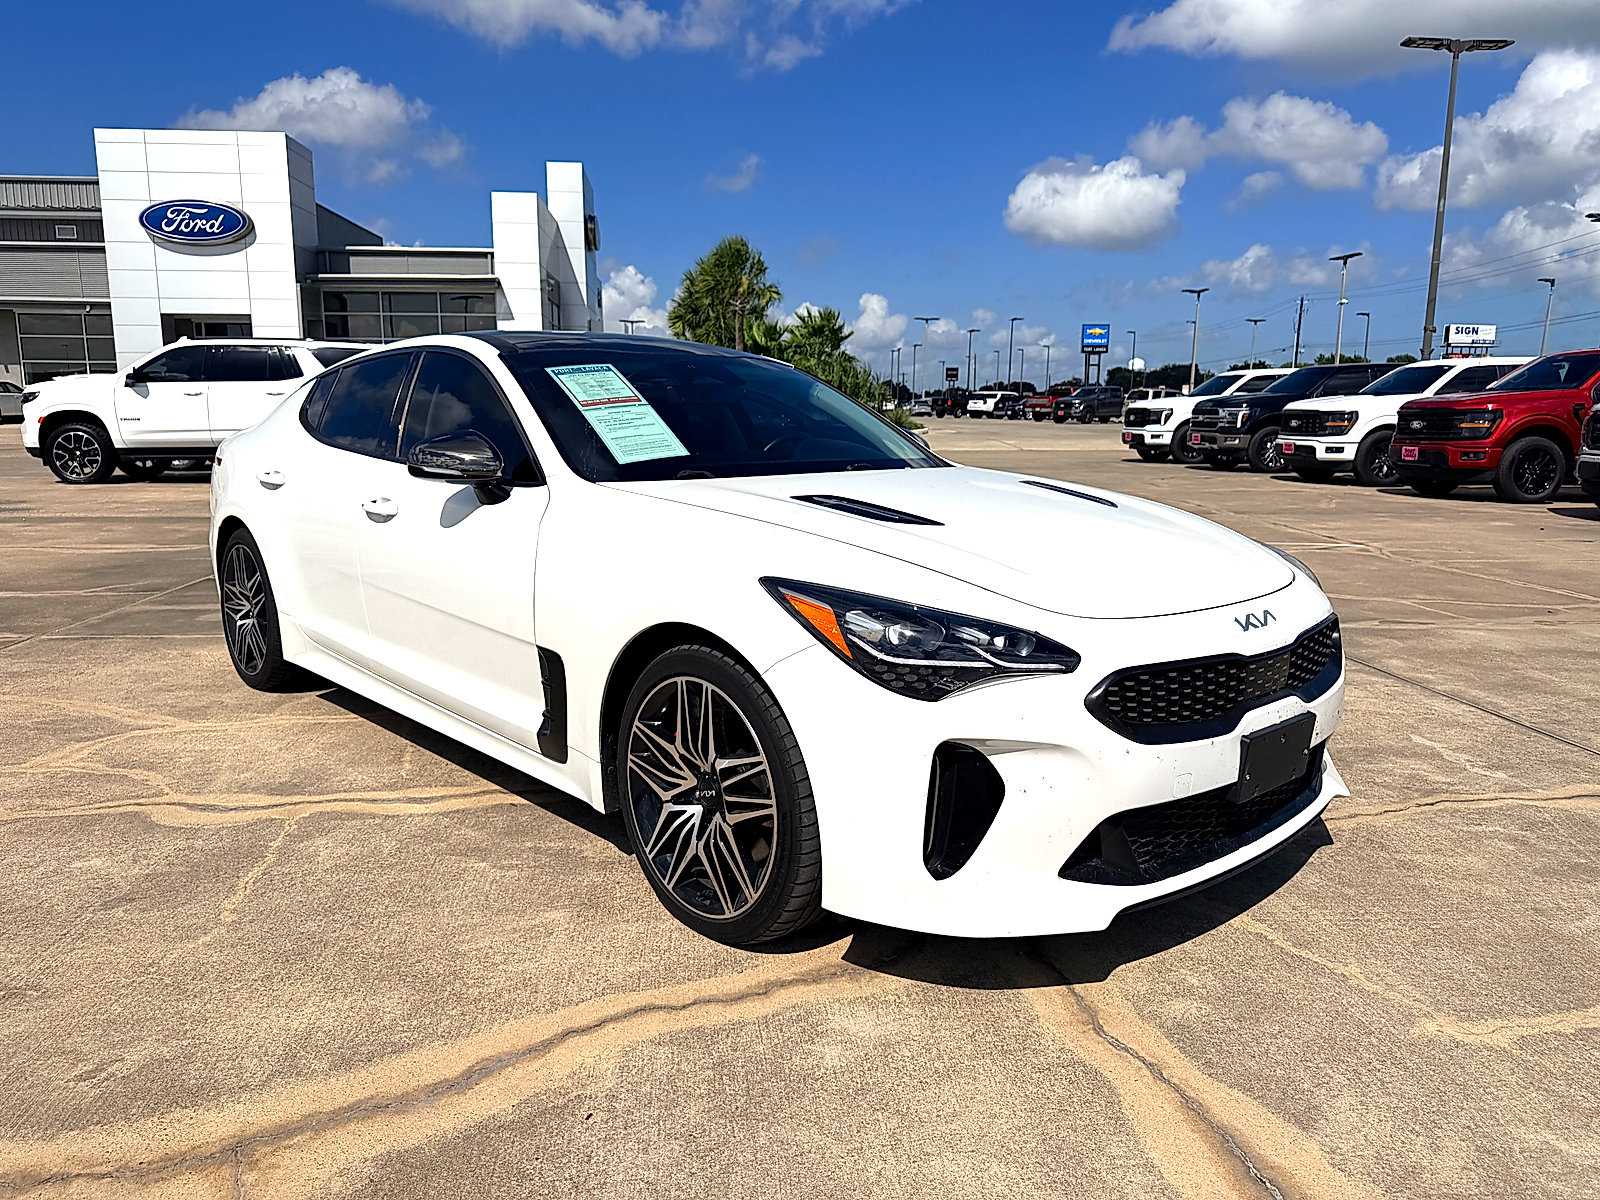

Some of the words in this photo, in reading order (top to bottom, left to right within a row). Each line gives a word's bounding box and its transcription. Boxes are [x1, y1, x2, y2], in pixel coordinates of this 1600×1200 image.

[161, 206, 224, 233] Ford
[1455, 326, 1479, 335] SIGN
[1234, 610, 1277, 632] KIA
